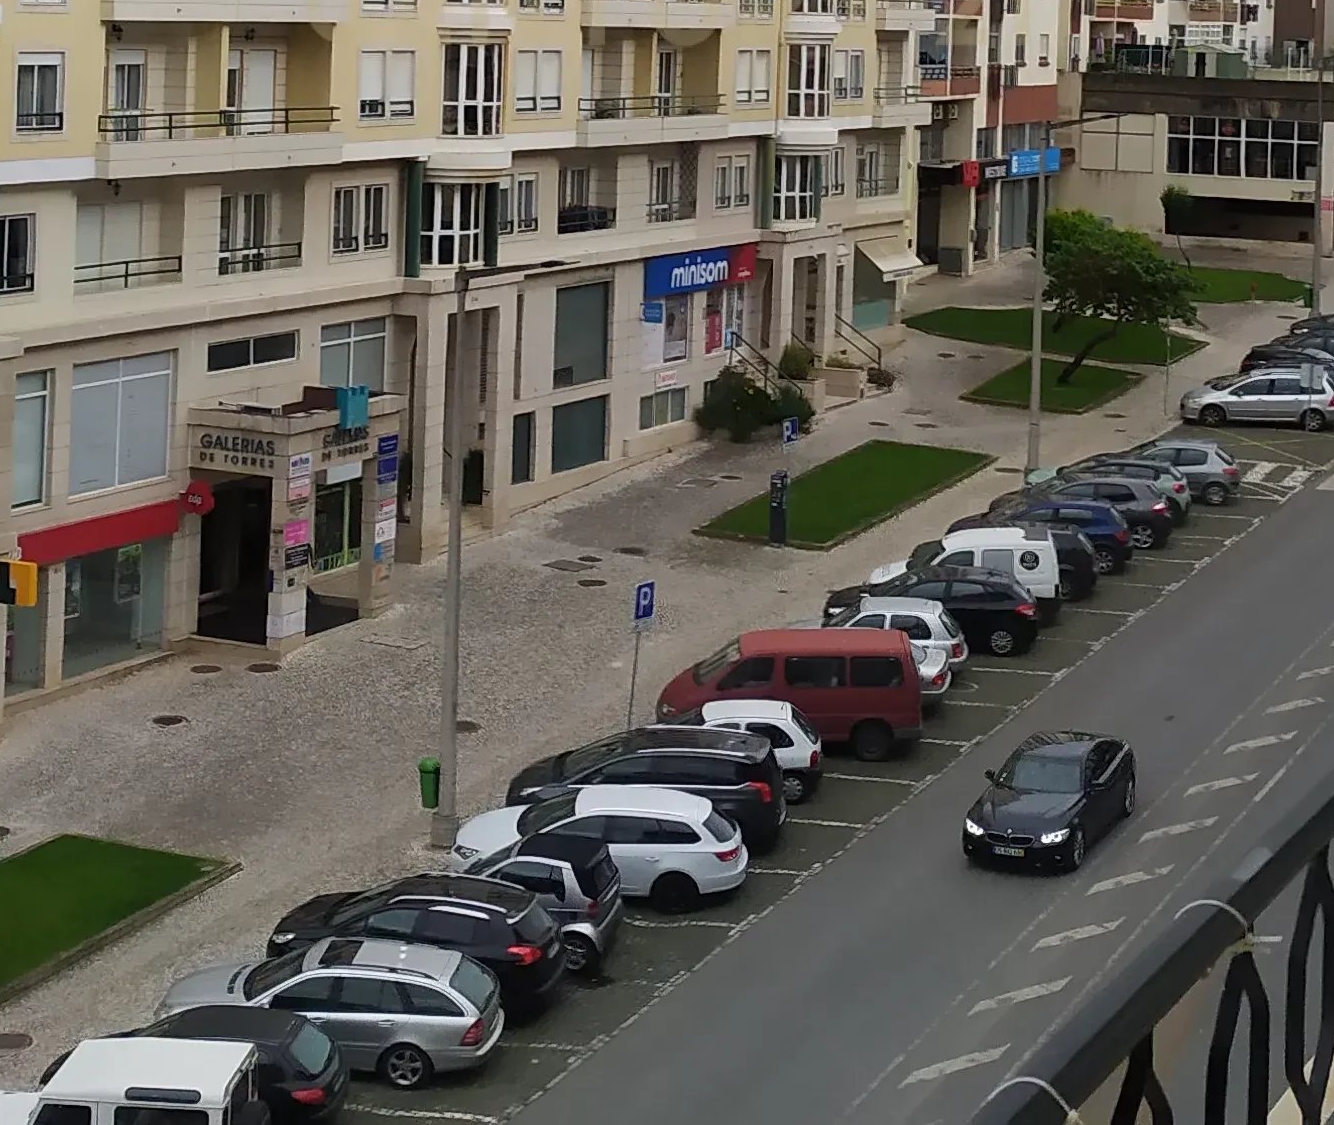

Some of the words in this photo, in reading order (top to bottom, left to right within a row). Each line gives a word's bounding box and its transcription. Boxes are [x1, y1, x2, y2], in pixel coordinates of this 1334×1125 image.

[670, 256, 728, 288] minisom
[200, 433, 275, 456] GALERIAS
[199, 451, 215, 462] DE
[224, 454, 275, 469] TORRES
[638, 586, 651, 616] P
